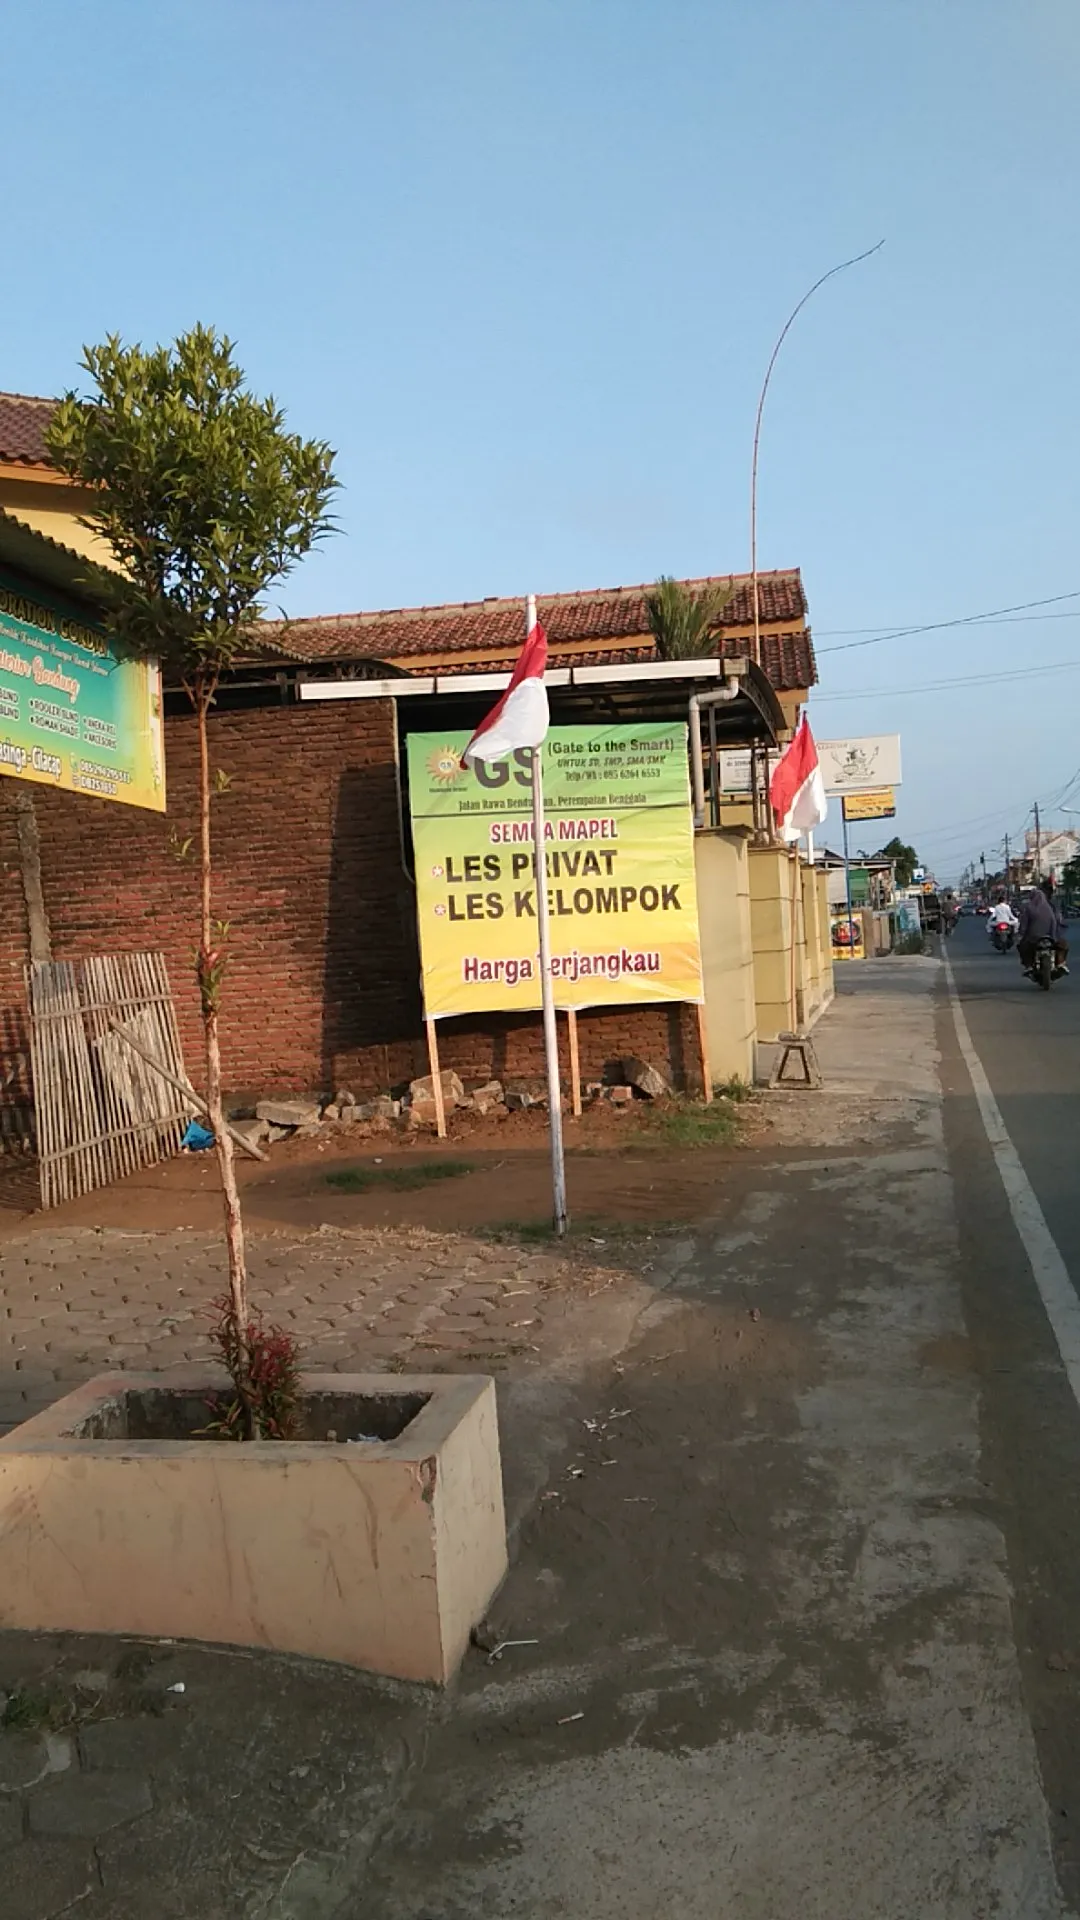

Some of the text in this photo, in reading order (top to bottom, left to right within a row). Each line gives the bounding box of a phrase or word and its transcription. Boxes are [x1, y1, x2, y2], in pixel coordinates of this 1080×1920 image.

[547, 737, 674, 756] (Gate to the Smart)
[32, 745, 61, 781] Cilacap
[459, 800, 480, 813] Jalan
[559, 819, 618, 840] MAPEL
[446, 855, 500, 882] LES
[449, 893, 504, 921] LES
[465, 950, 660, 985] Harga erjangkau
